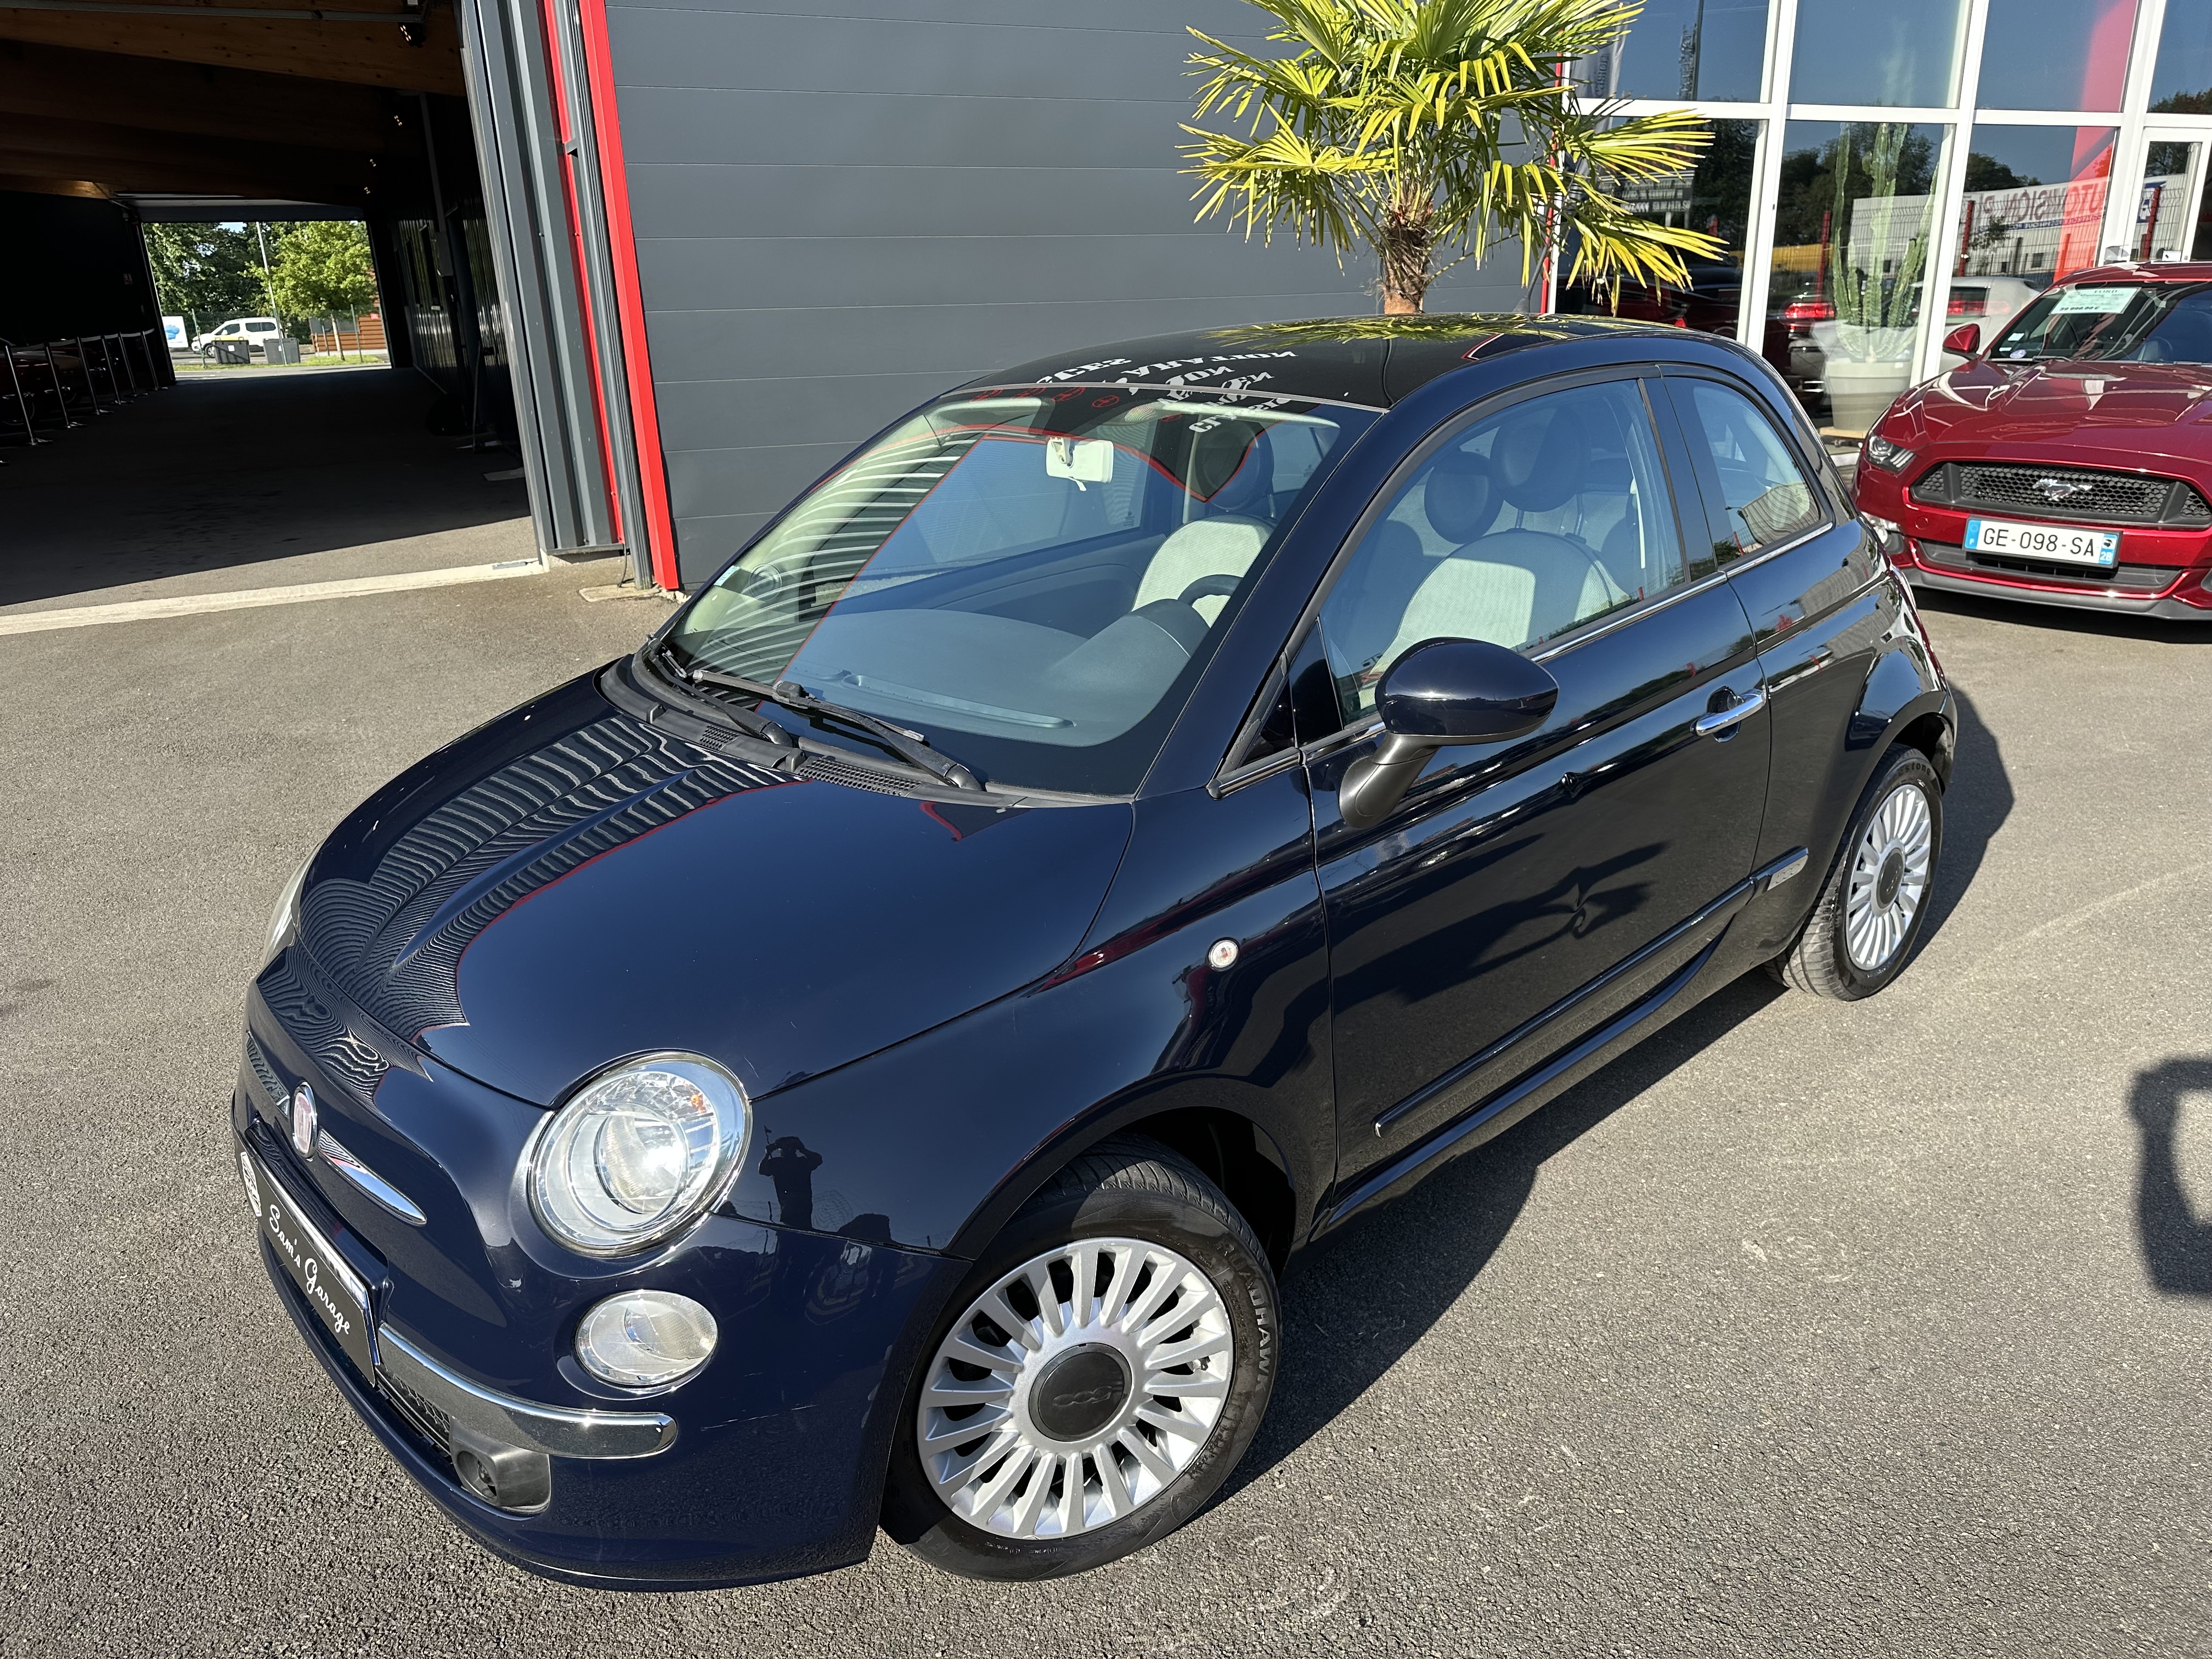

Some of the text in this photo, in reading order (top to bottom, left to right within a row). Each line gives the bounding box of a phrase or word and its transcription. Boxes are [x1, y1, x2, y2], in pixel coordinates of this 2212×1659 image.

[1983, 528, 2095, 557] GE-098-SA
[2100, 551, 2112, 562] 2B
[269, 1204, 351, 1335] Sam's Garage
